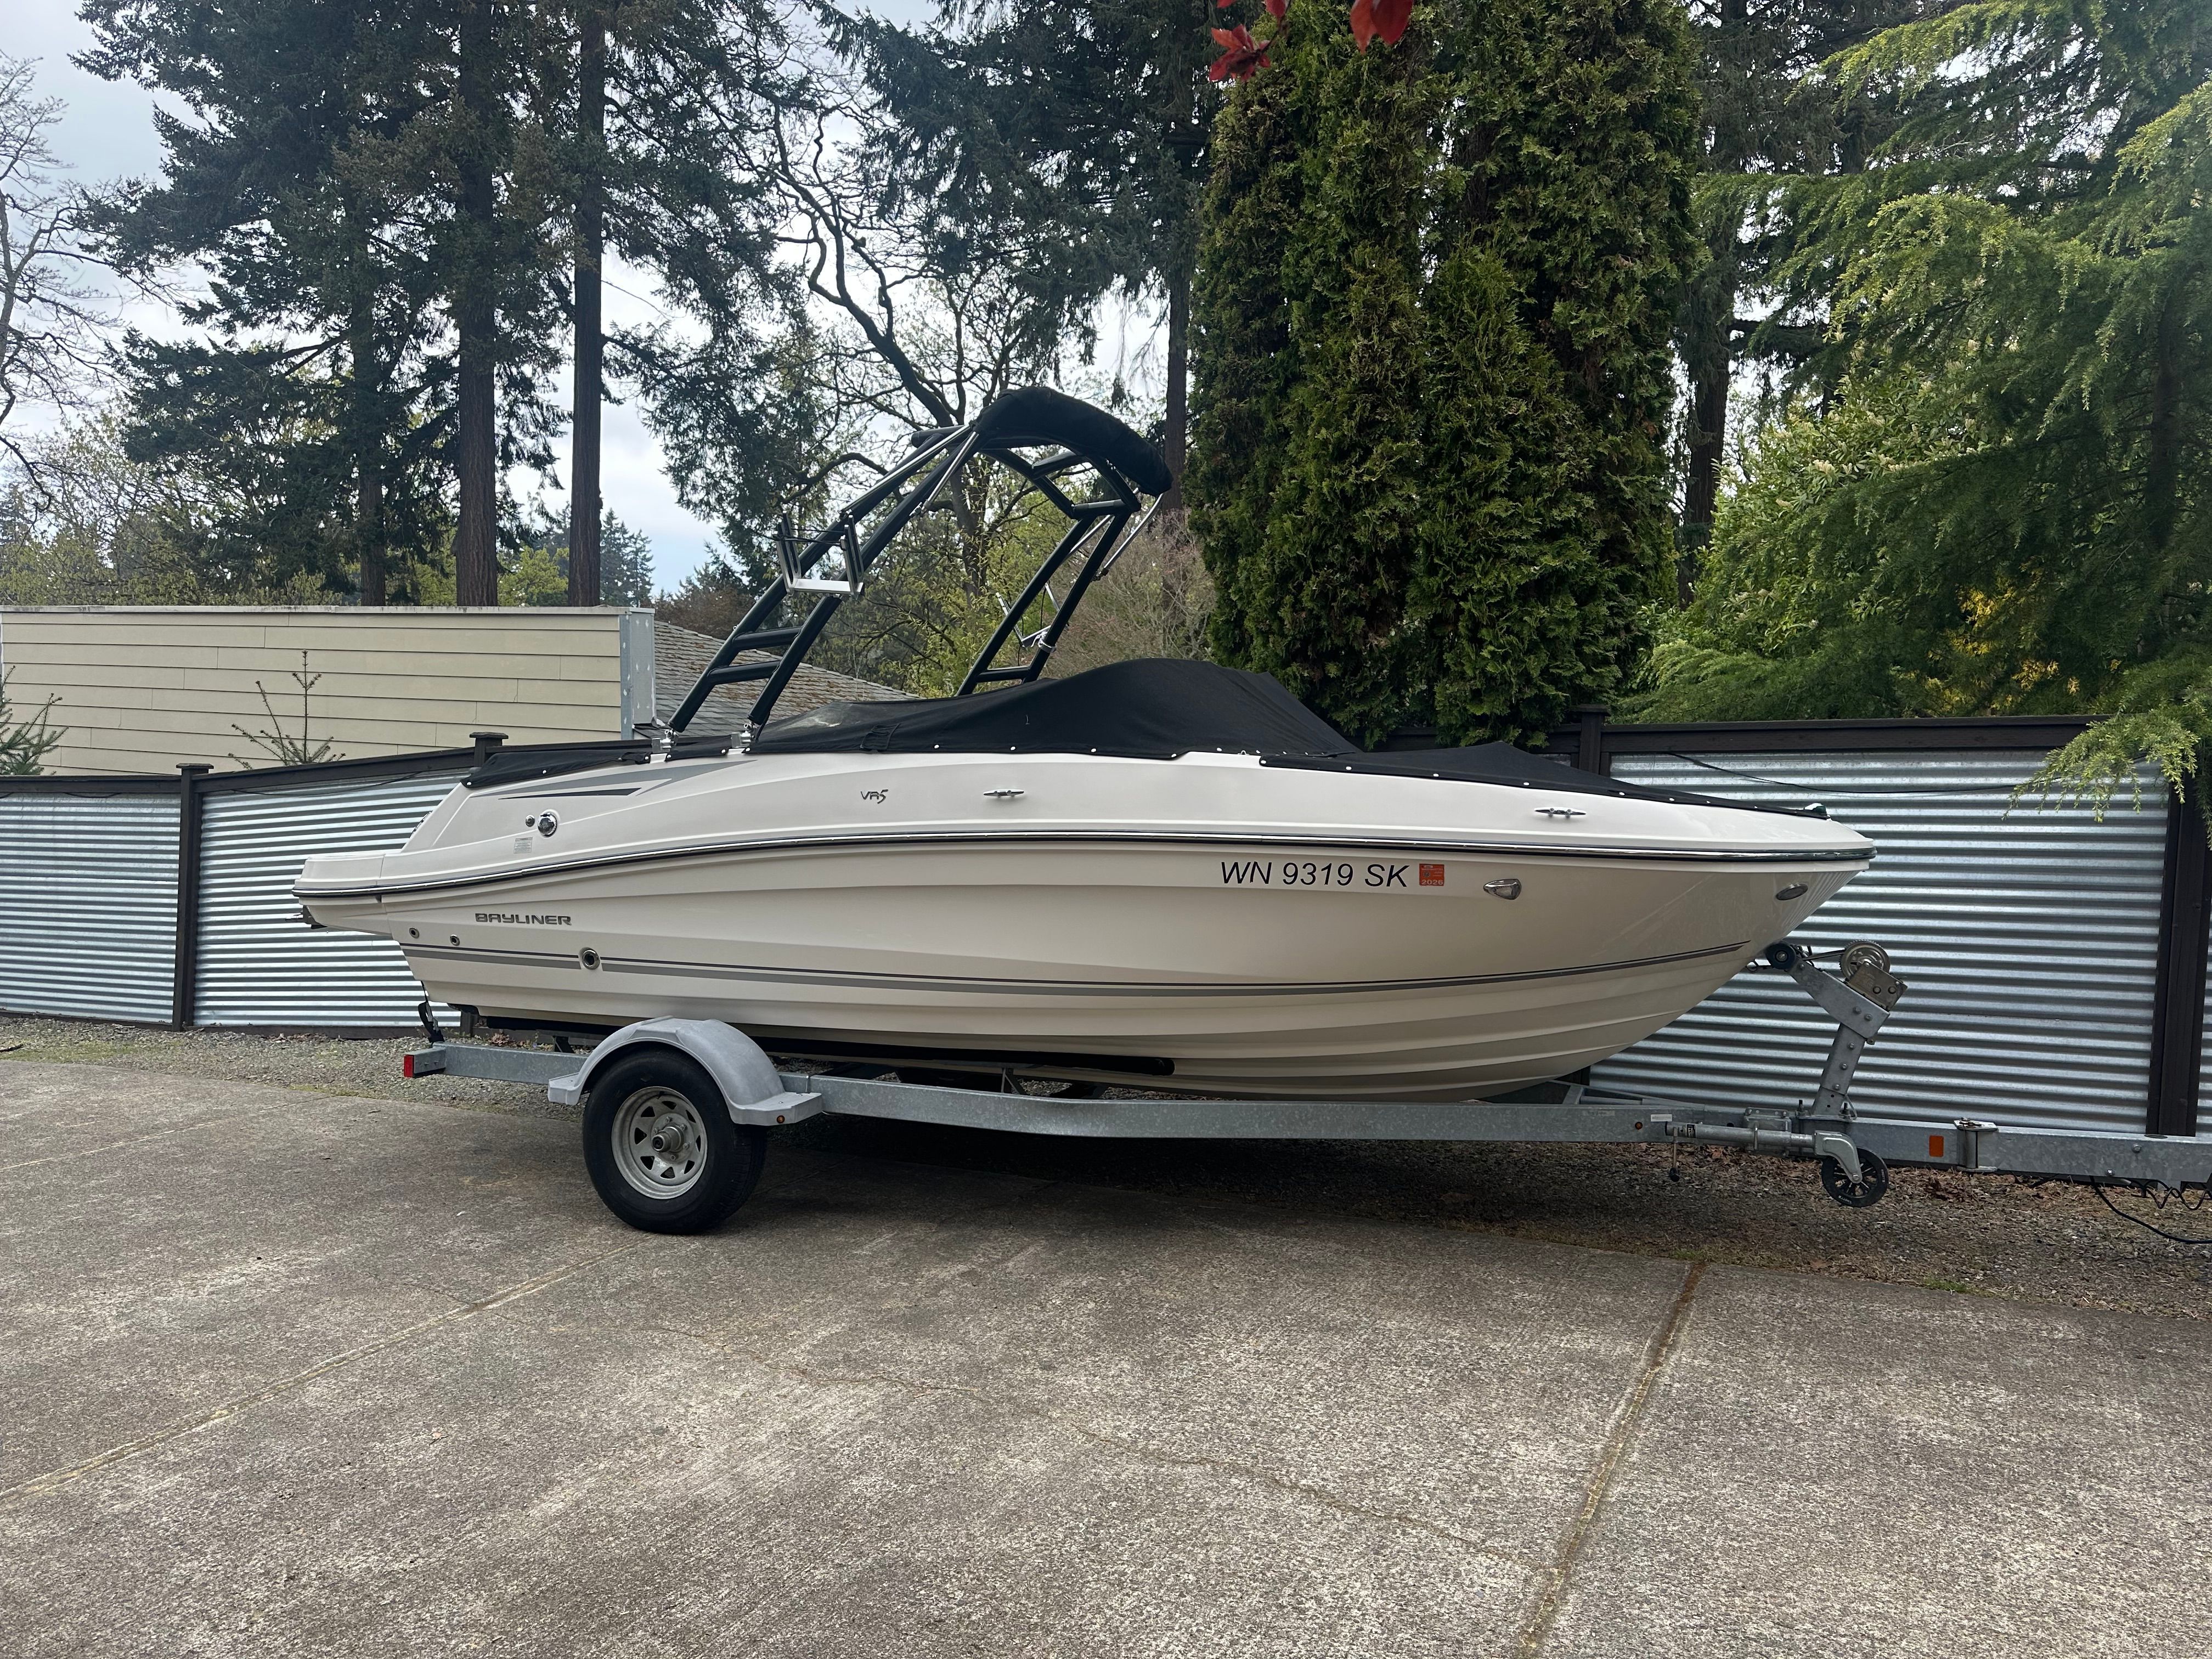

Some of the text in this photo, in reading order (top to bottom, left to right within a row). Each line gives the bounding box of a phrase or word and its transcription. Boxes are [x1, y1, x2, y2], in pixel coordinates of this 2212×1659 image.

[1221, 861, 1272, 884] WN
[1283, 862, 1353, 886] 9319
[1364, 864, 1410, 888] SK
[475, 913, 572, 926] BAYLINER
